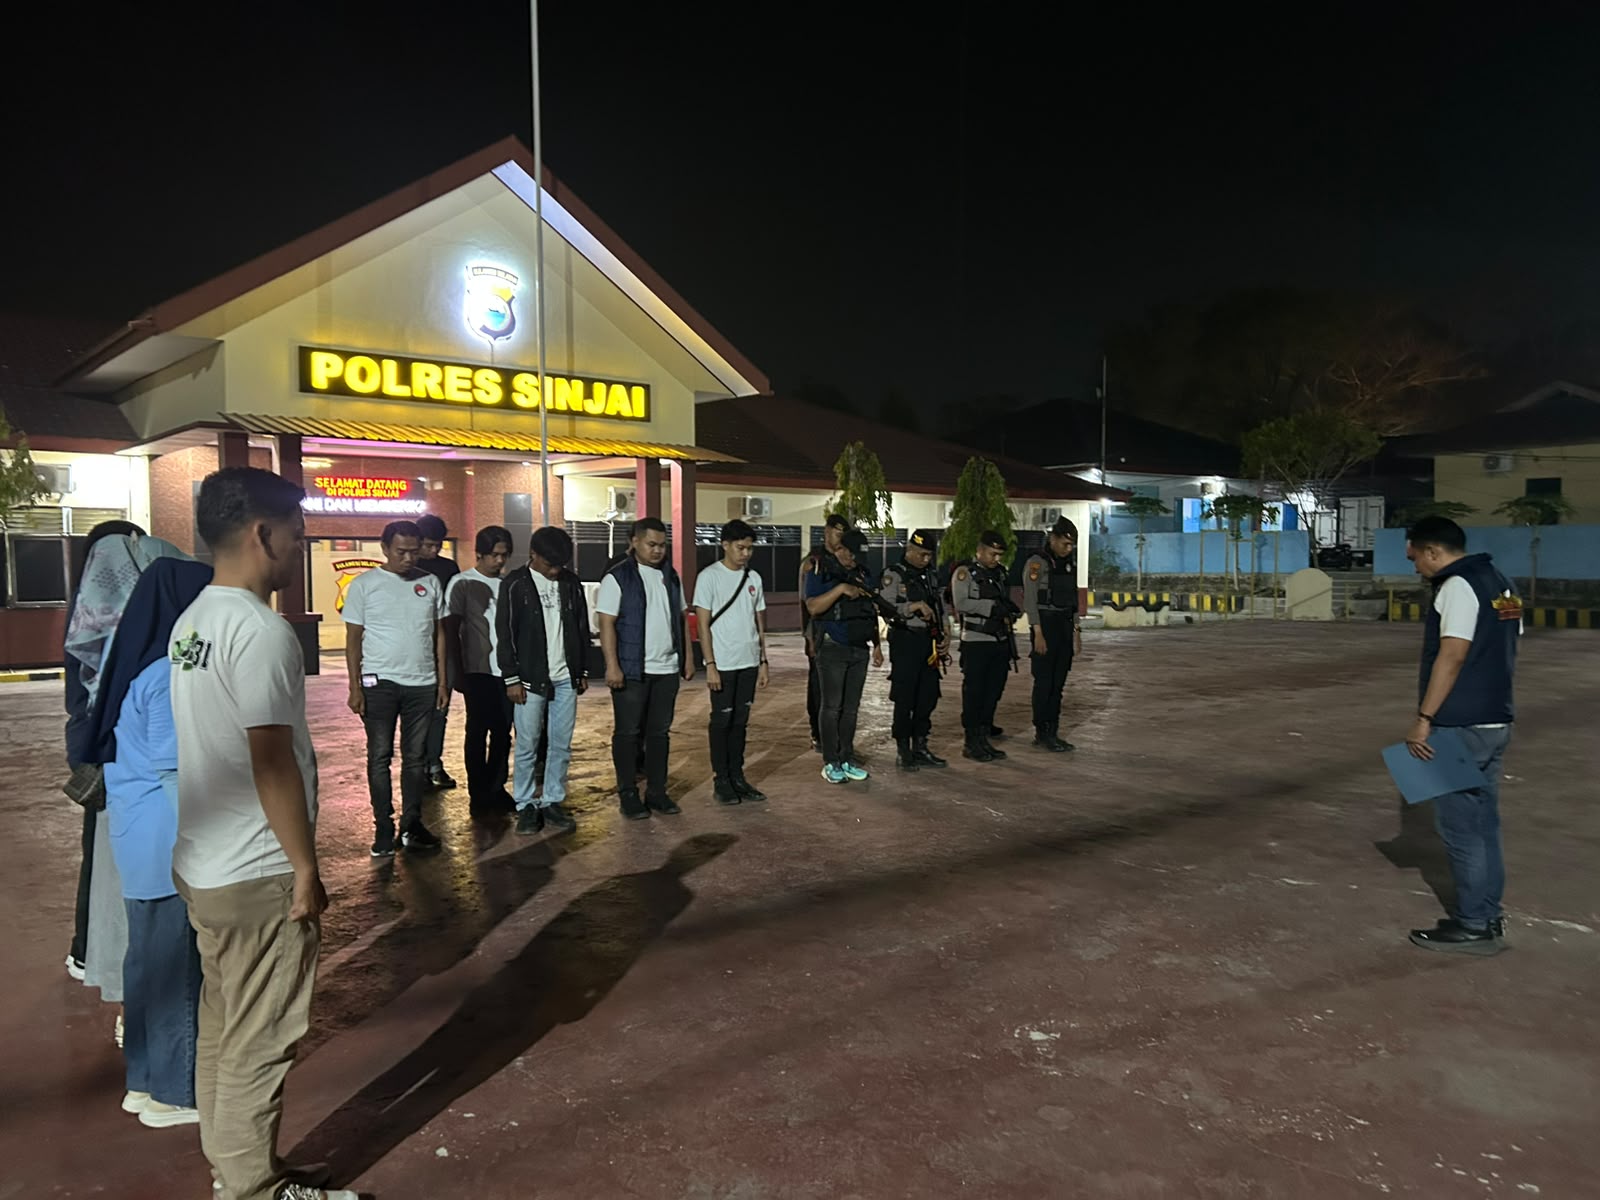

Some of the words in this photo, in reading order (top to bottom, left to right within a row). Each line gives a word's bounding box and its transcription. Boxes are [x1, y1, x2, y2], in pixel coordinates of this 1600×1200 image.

[310, 352, 503, 404] POLRES
[511, 372, 646, 418] SINJAI
[315, 478, 364, 489] SELAMAT
[366, 479, 407, 491] DATANG
[326, 488, 337, 497] DI
[338, 488, 371, 497] POLRES
[372, 489, 400, 498] SINJAI
[324, 498, 353, 513] DAN
